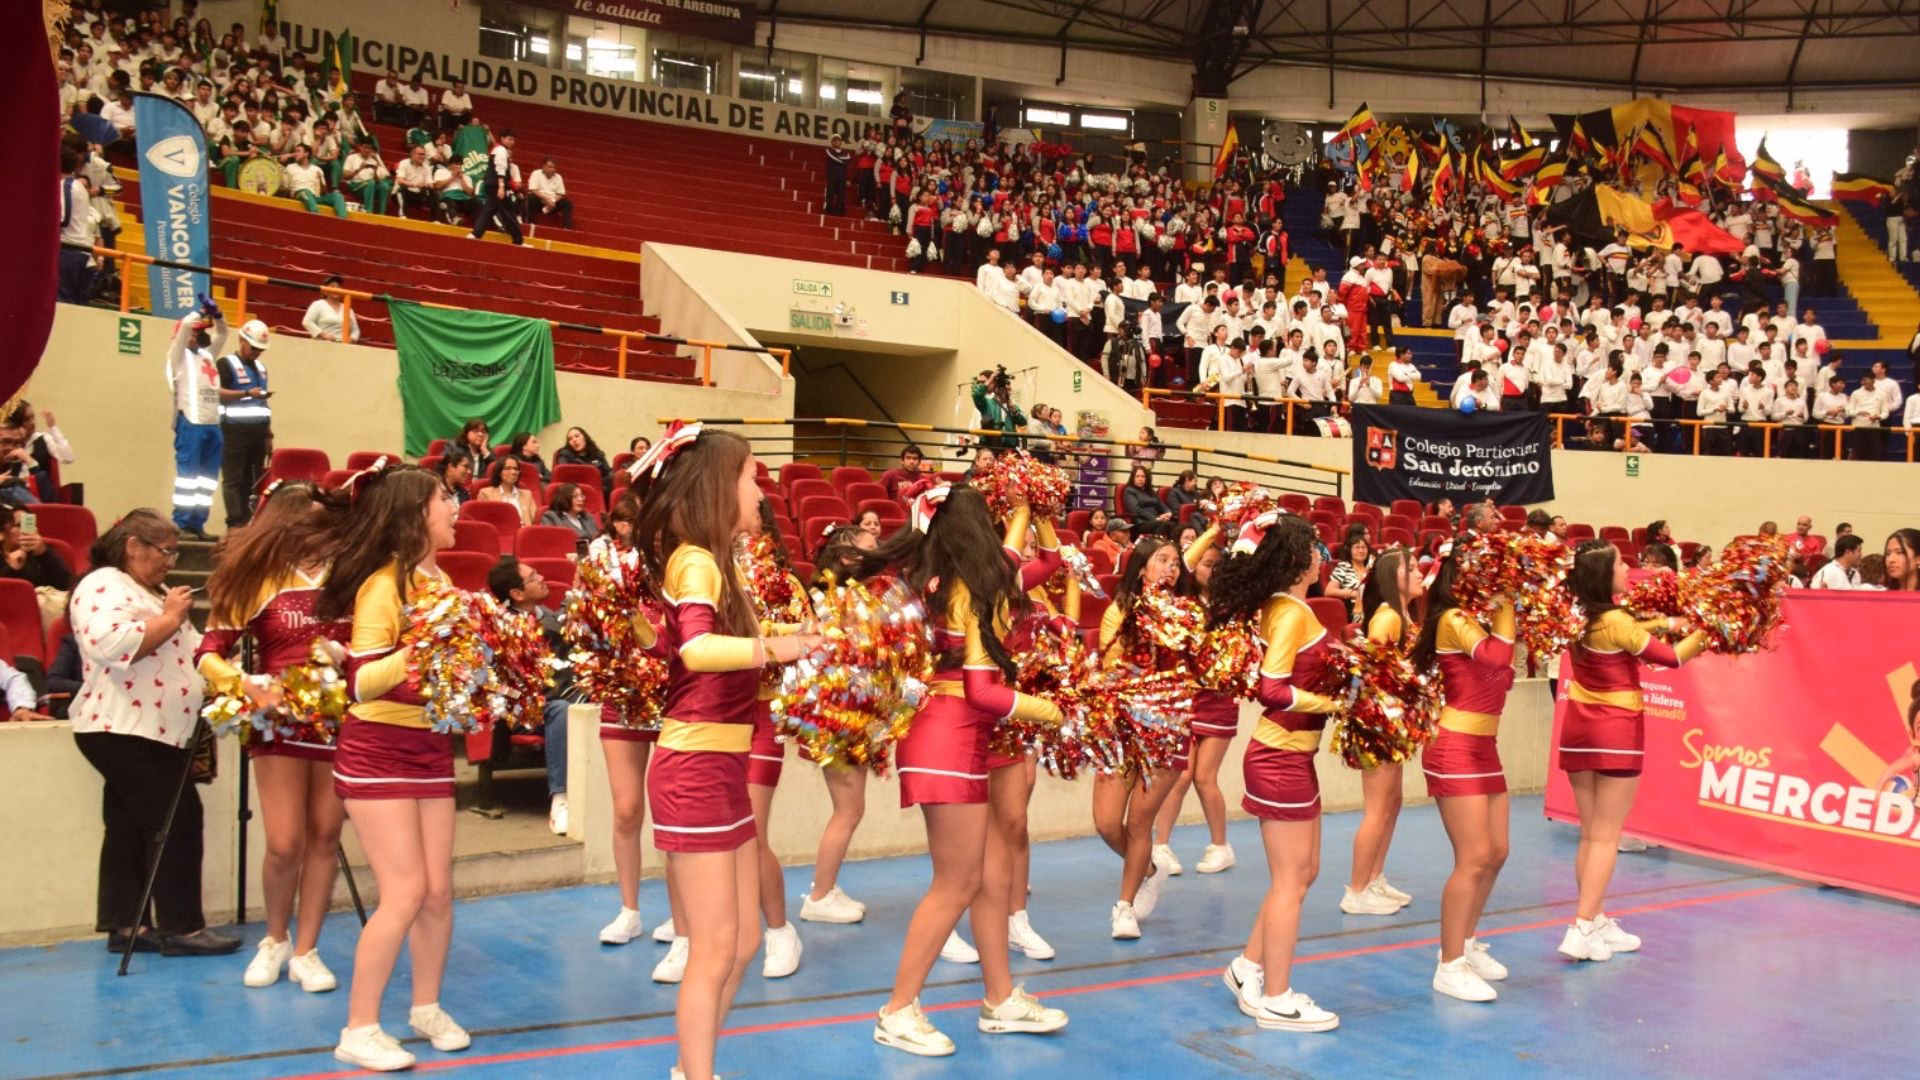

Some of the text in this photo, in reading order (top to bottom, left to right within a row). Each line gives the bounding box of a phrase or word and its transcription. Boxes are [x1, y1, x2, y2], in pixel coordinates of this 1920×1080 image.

[596, 4, 662, 25] saluda
[683, 0, 741, 19] AREQUIPA
[550, 75, 720, 125] PROVINCIAL
[728, 103, 764, 132] DE
[1208, 101, 1217, 111] S
[461, 150, 489, 171] alle
[187, 183, 201, 225] Colegio
[796, 282, 818, 293] SALIDA
[896, 292, 905, 304] 5
[791, 313, 832, 330] SALIDA
[1404, 436, 1461, 459] Colegio
[1403, 452, 1541, 478] San Jerónimo
[1639, 681, 1673, 693] REQUIPA
[1680, 728, 1773, 769] Somos
